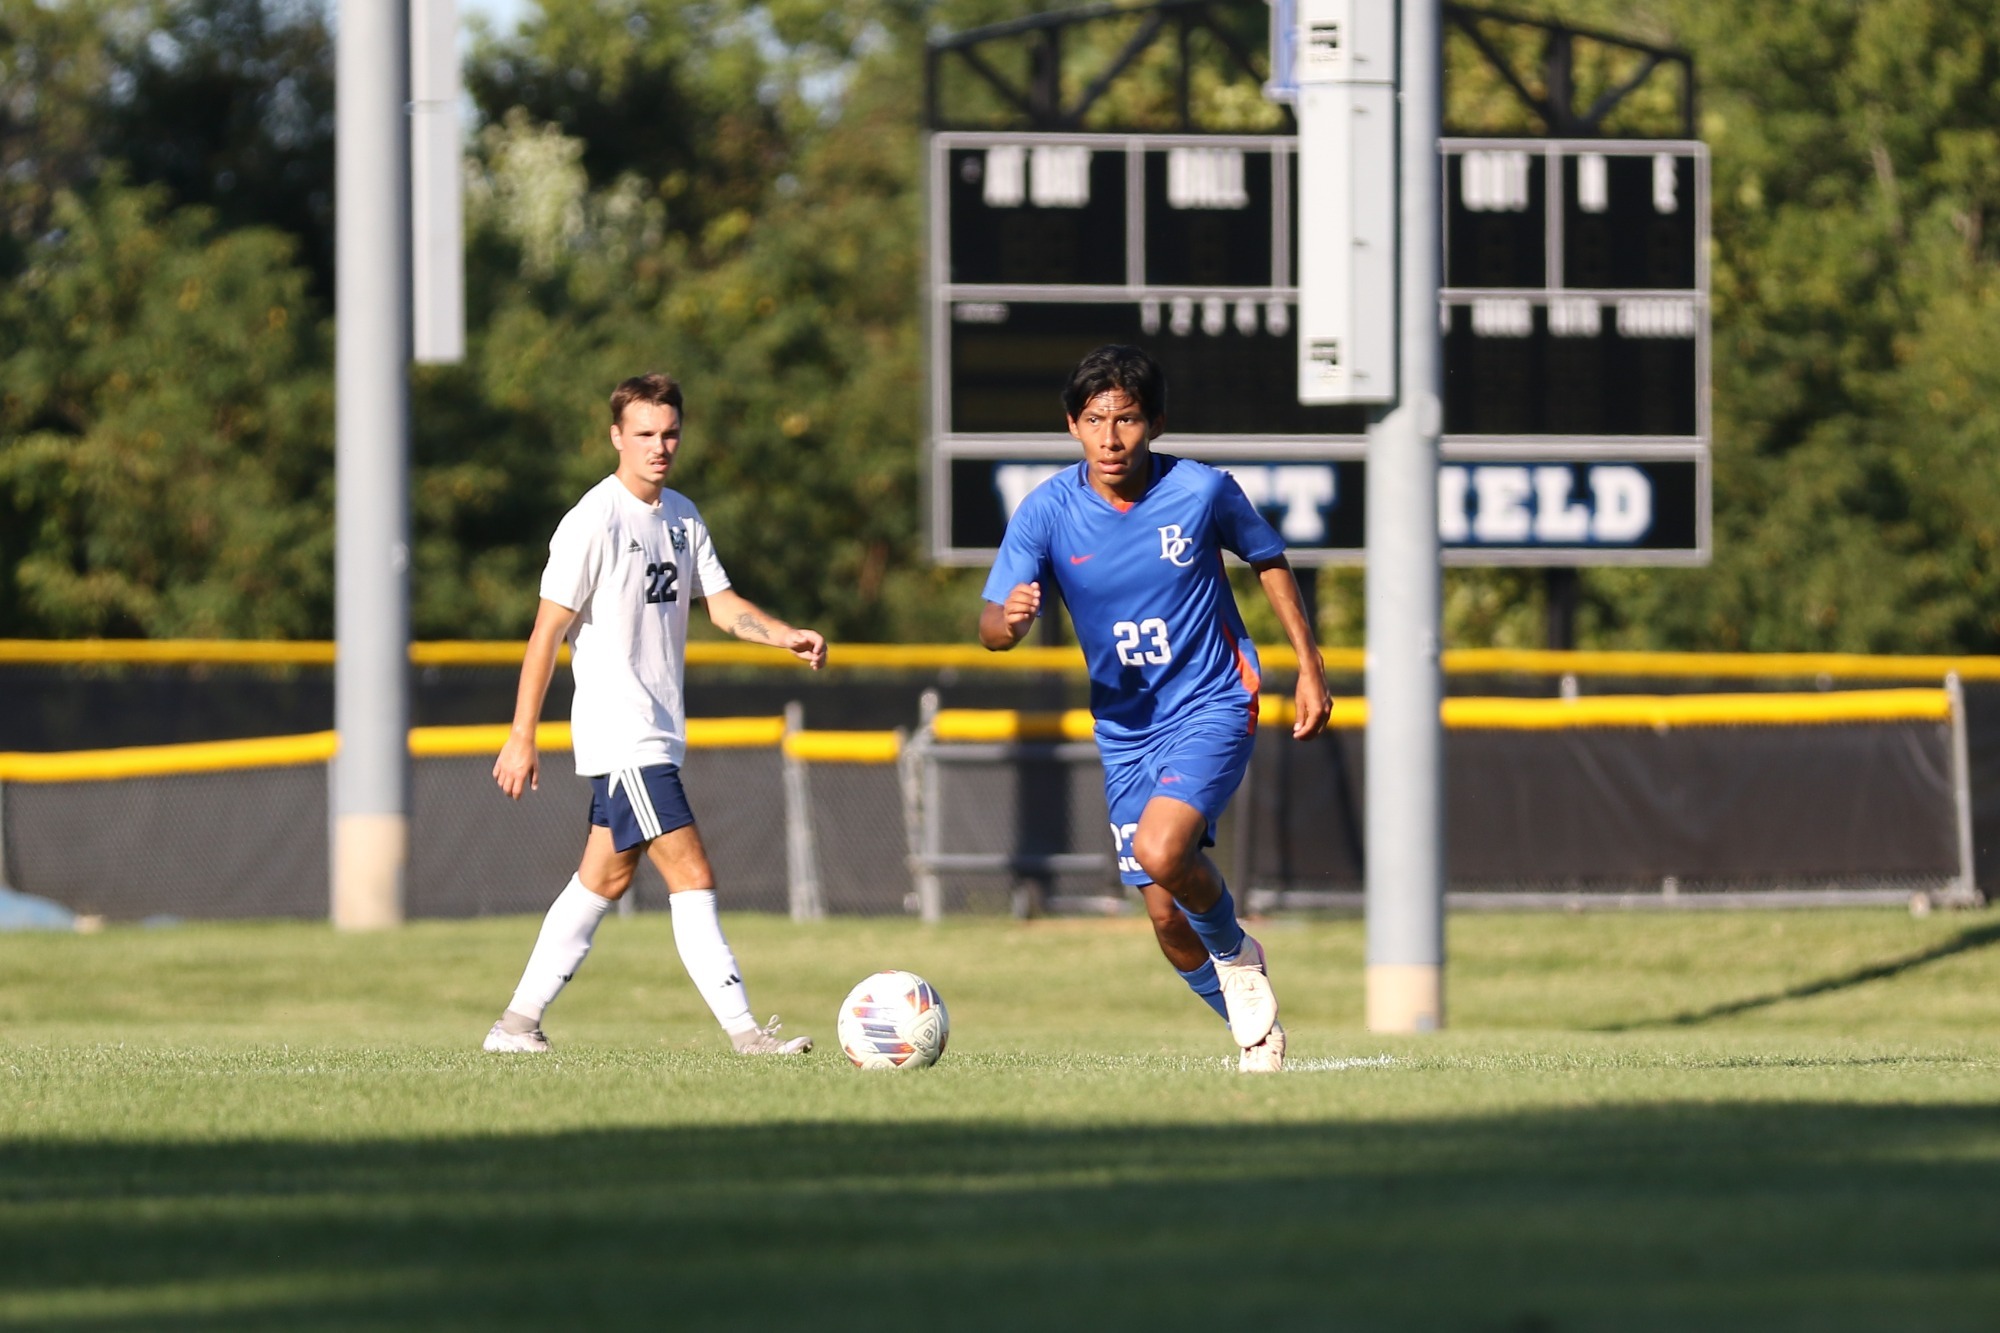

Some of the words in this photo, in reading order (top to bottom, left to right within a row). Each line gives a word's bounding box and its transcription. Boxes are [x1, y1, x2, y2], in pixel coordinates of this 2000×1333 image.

[1440, 464, 1651, 541] IELD
[646, 562, 678, 604] 22
[1113, 618, 1172, 666] 23
